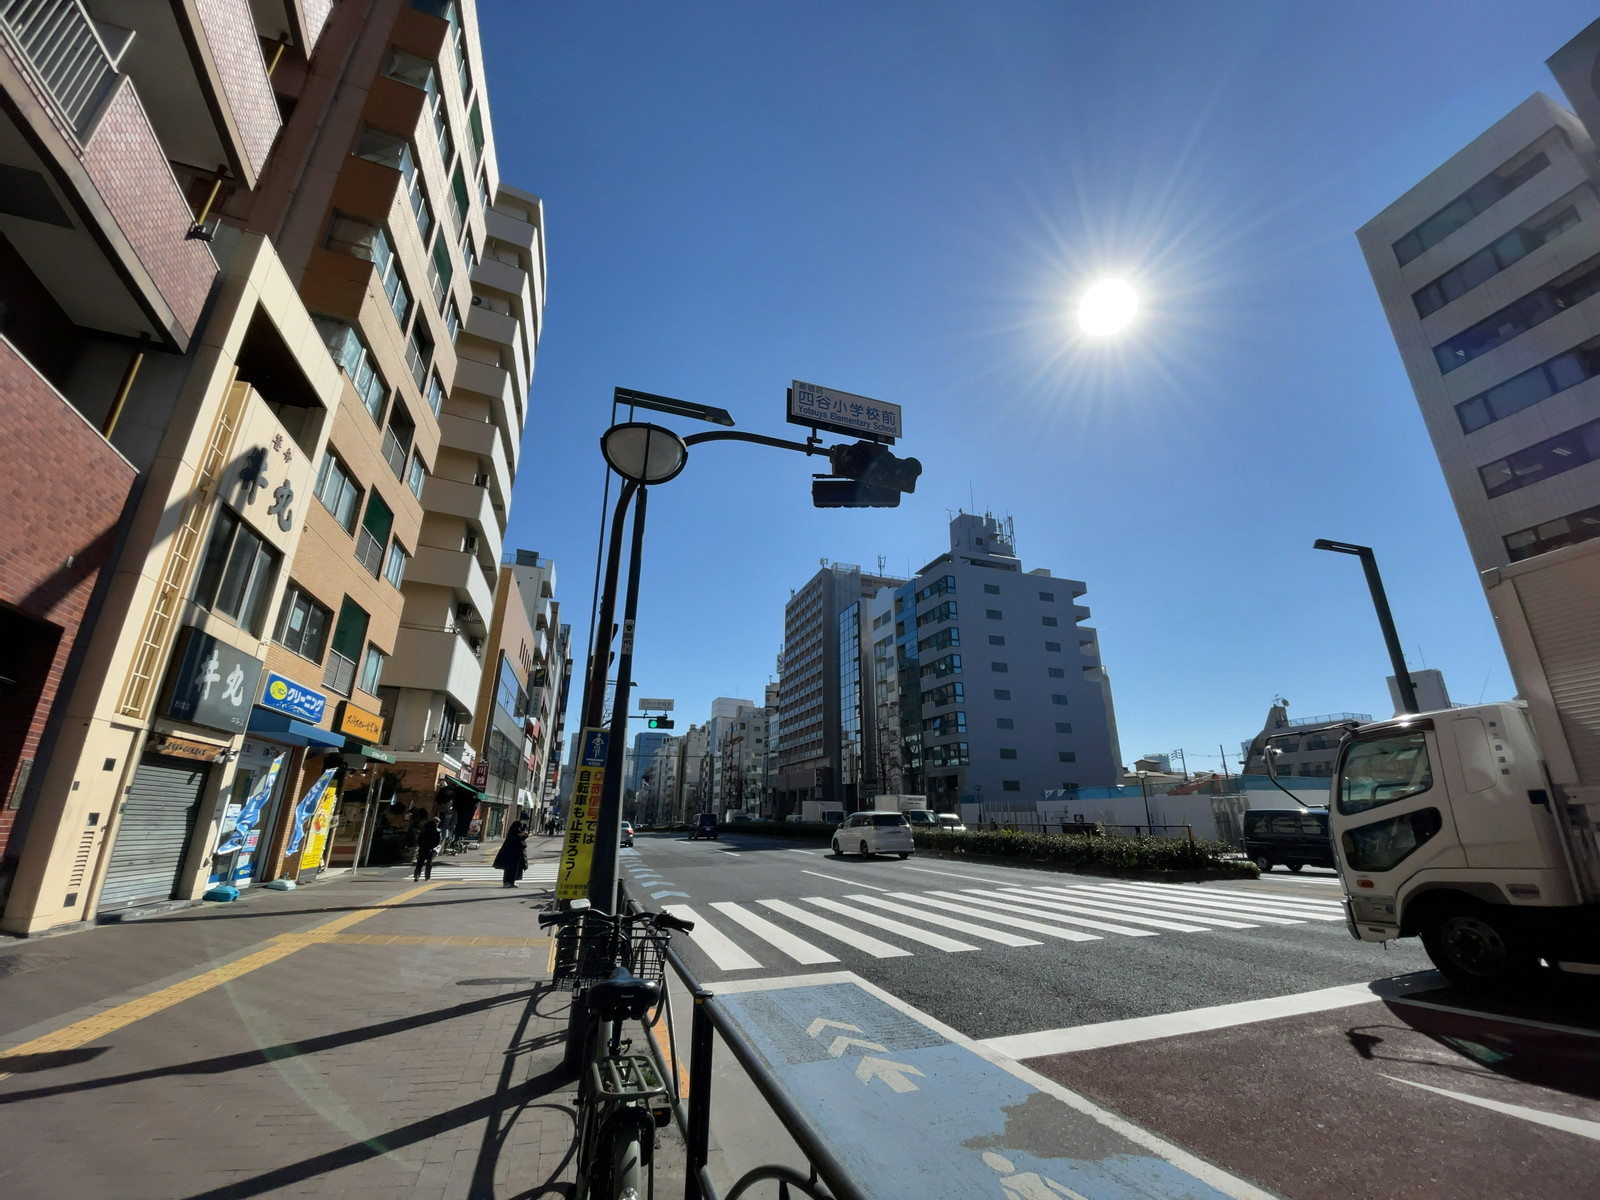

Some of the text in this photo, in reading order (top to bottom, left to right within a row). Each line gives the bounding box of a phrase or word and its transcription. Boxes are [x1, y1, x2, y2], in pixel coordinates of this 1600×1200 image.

[798, 405, 897, 433] Yotsuya Elementary School
[799, 391, 896, 426] 四谷小学校前
[286, 687, 325, 712] クリーニング
[582, 783, 603, 845] 赤信号では
